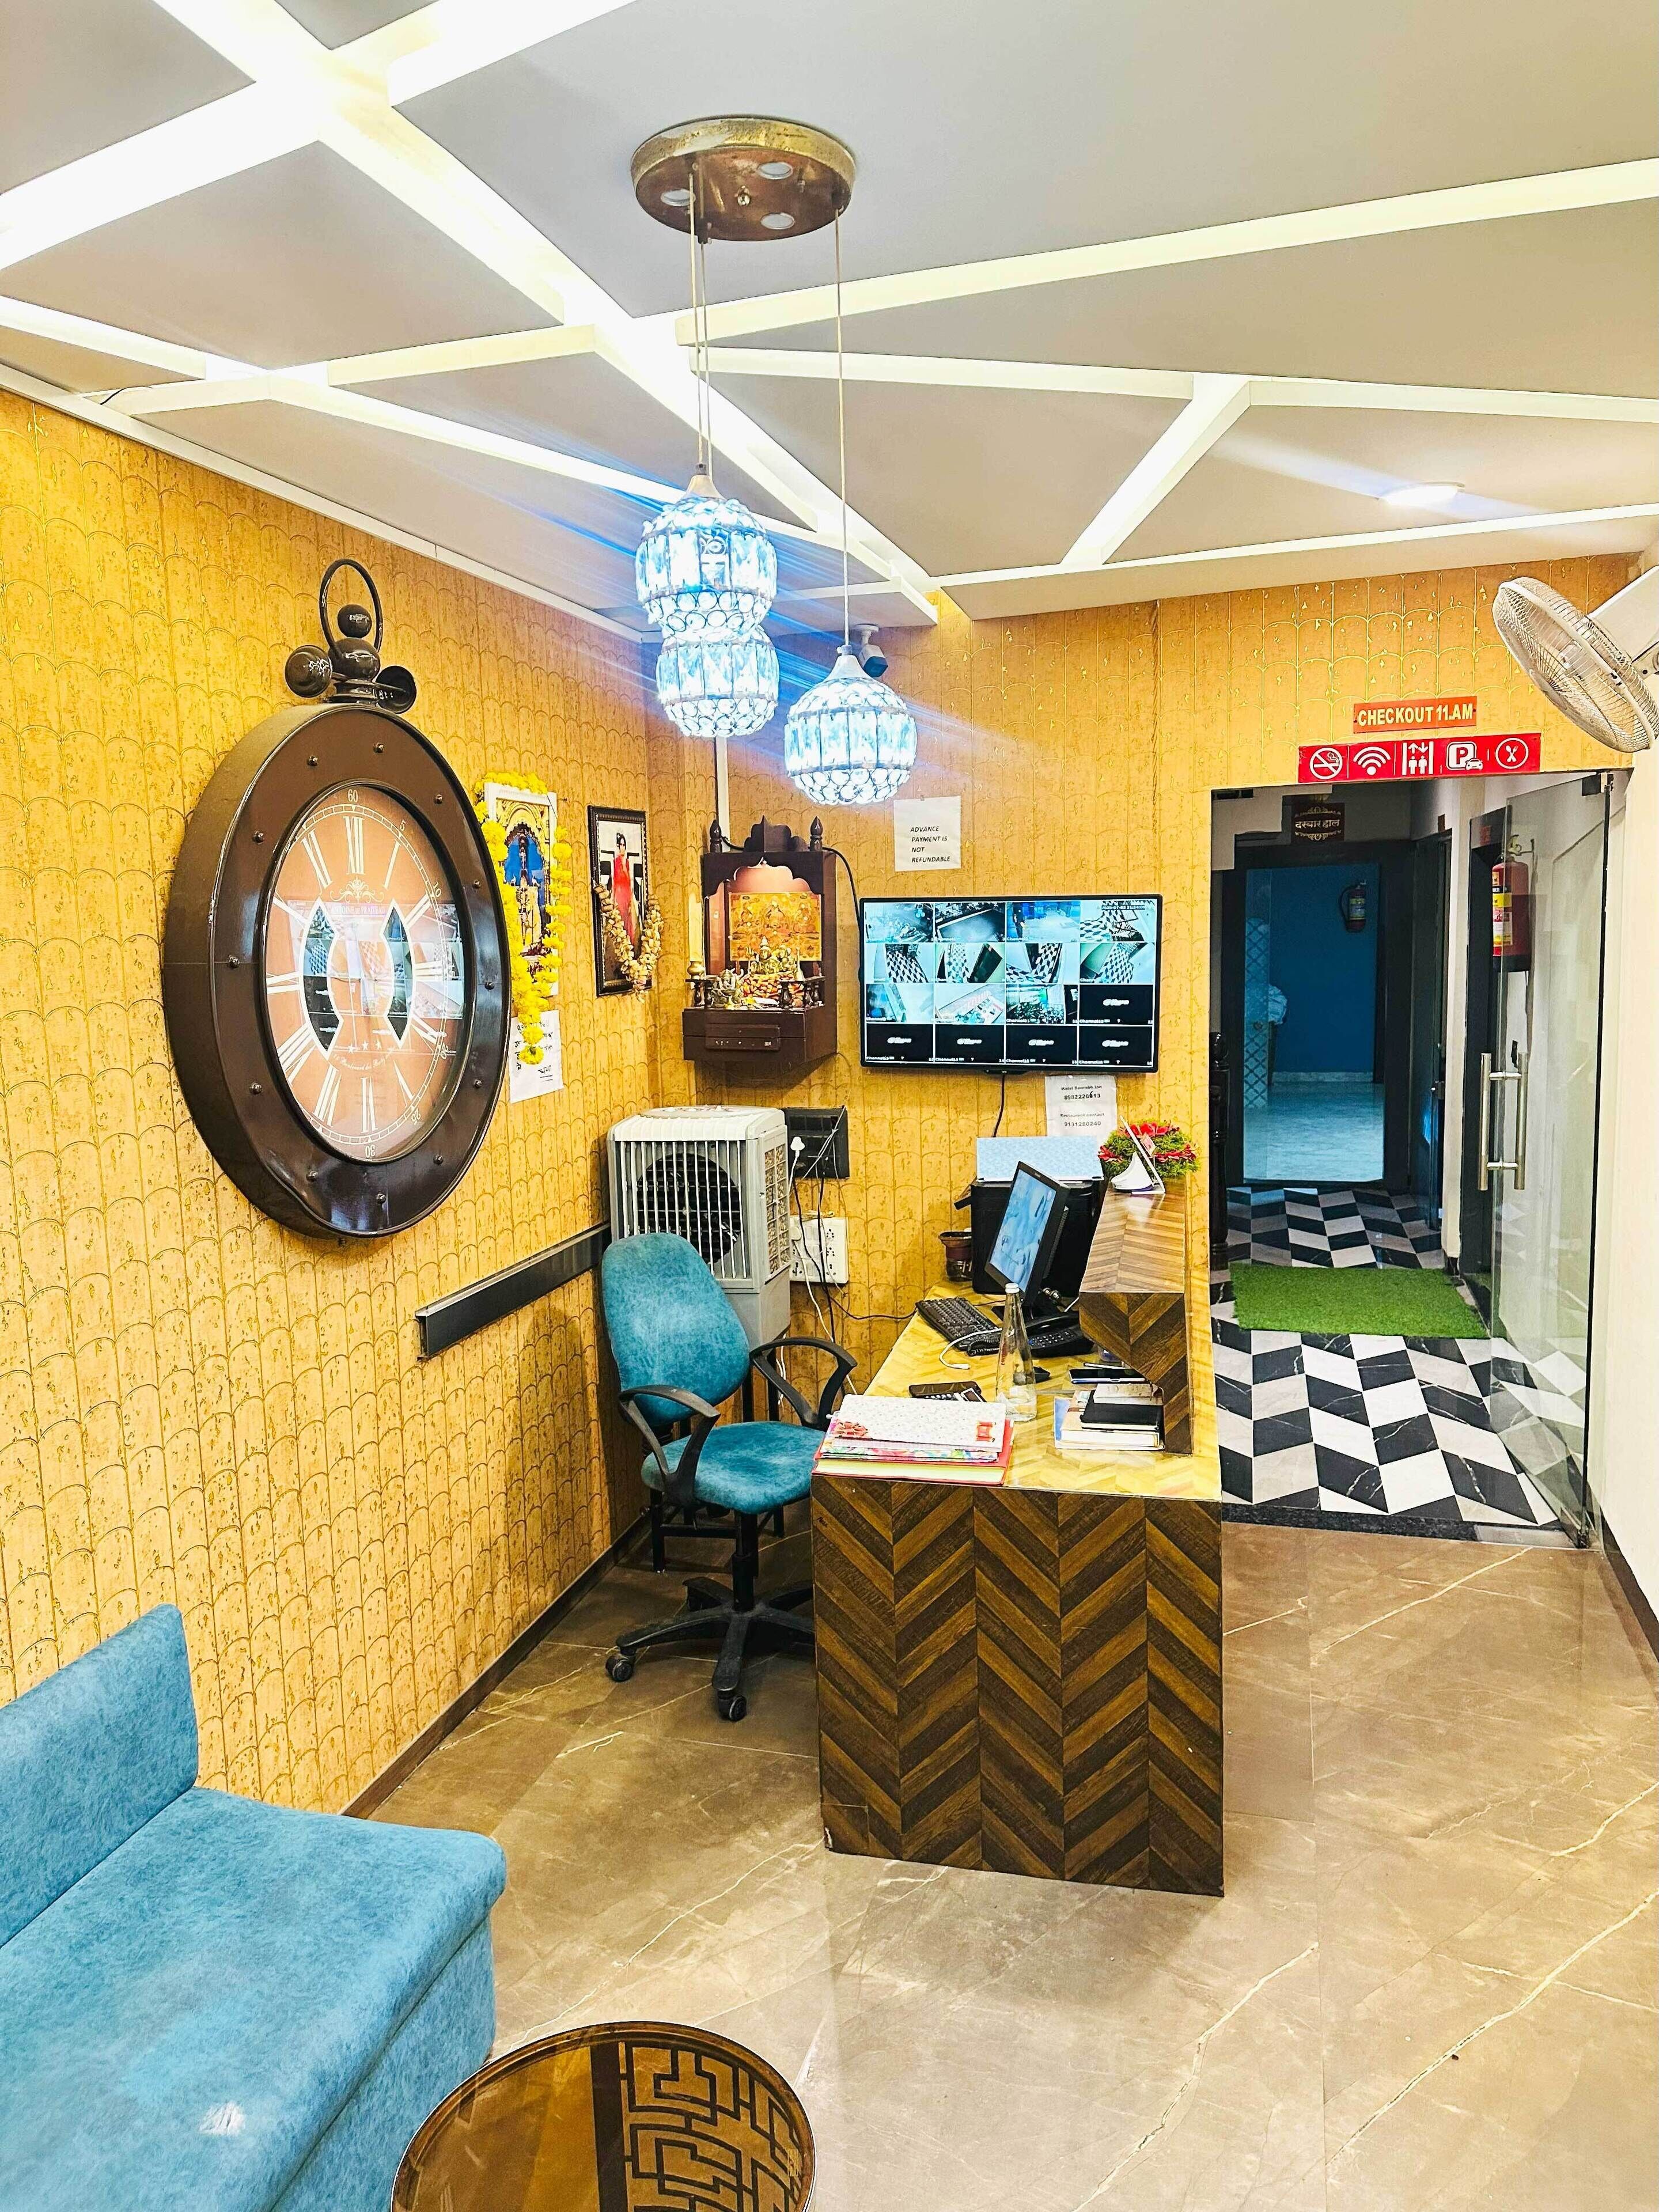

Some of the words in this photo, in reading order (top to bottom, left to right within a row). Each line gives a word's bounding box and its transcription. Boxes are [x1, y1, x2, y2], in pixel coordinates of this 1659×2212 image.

[1358, 706, 1434, 726] CHECKOUT
[1436, 703, 1473, 721] 11.AM
[347, 789, 358, 803] 60
[399, 819, 407, 832] 5
[343, 816, 365, 875] XII
[432, 881, 442, 898] 10
[365, 1145, 375, 1158] 30
